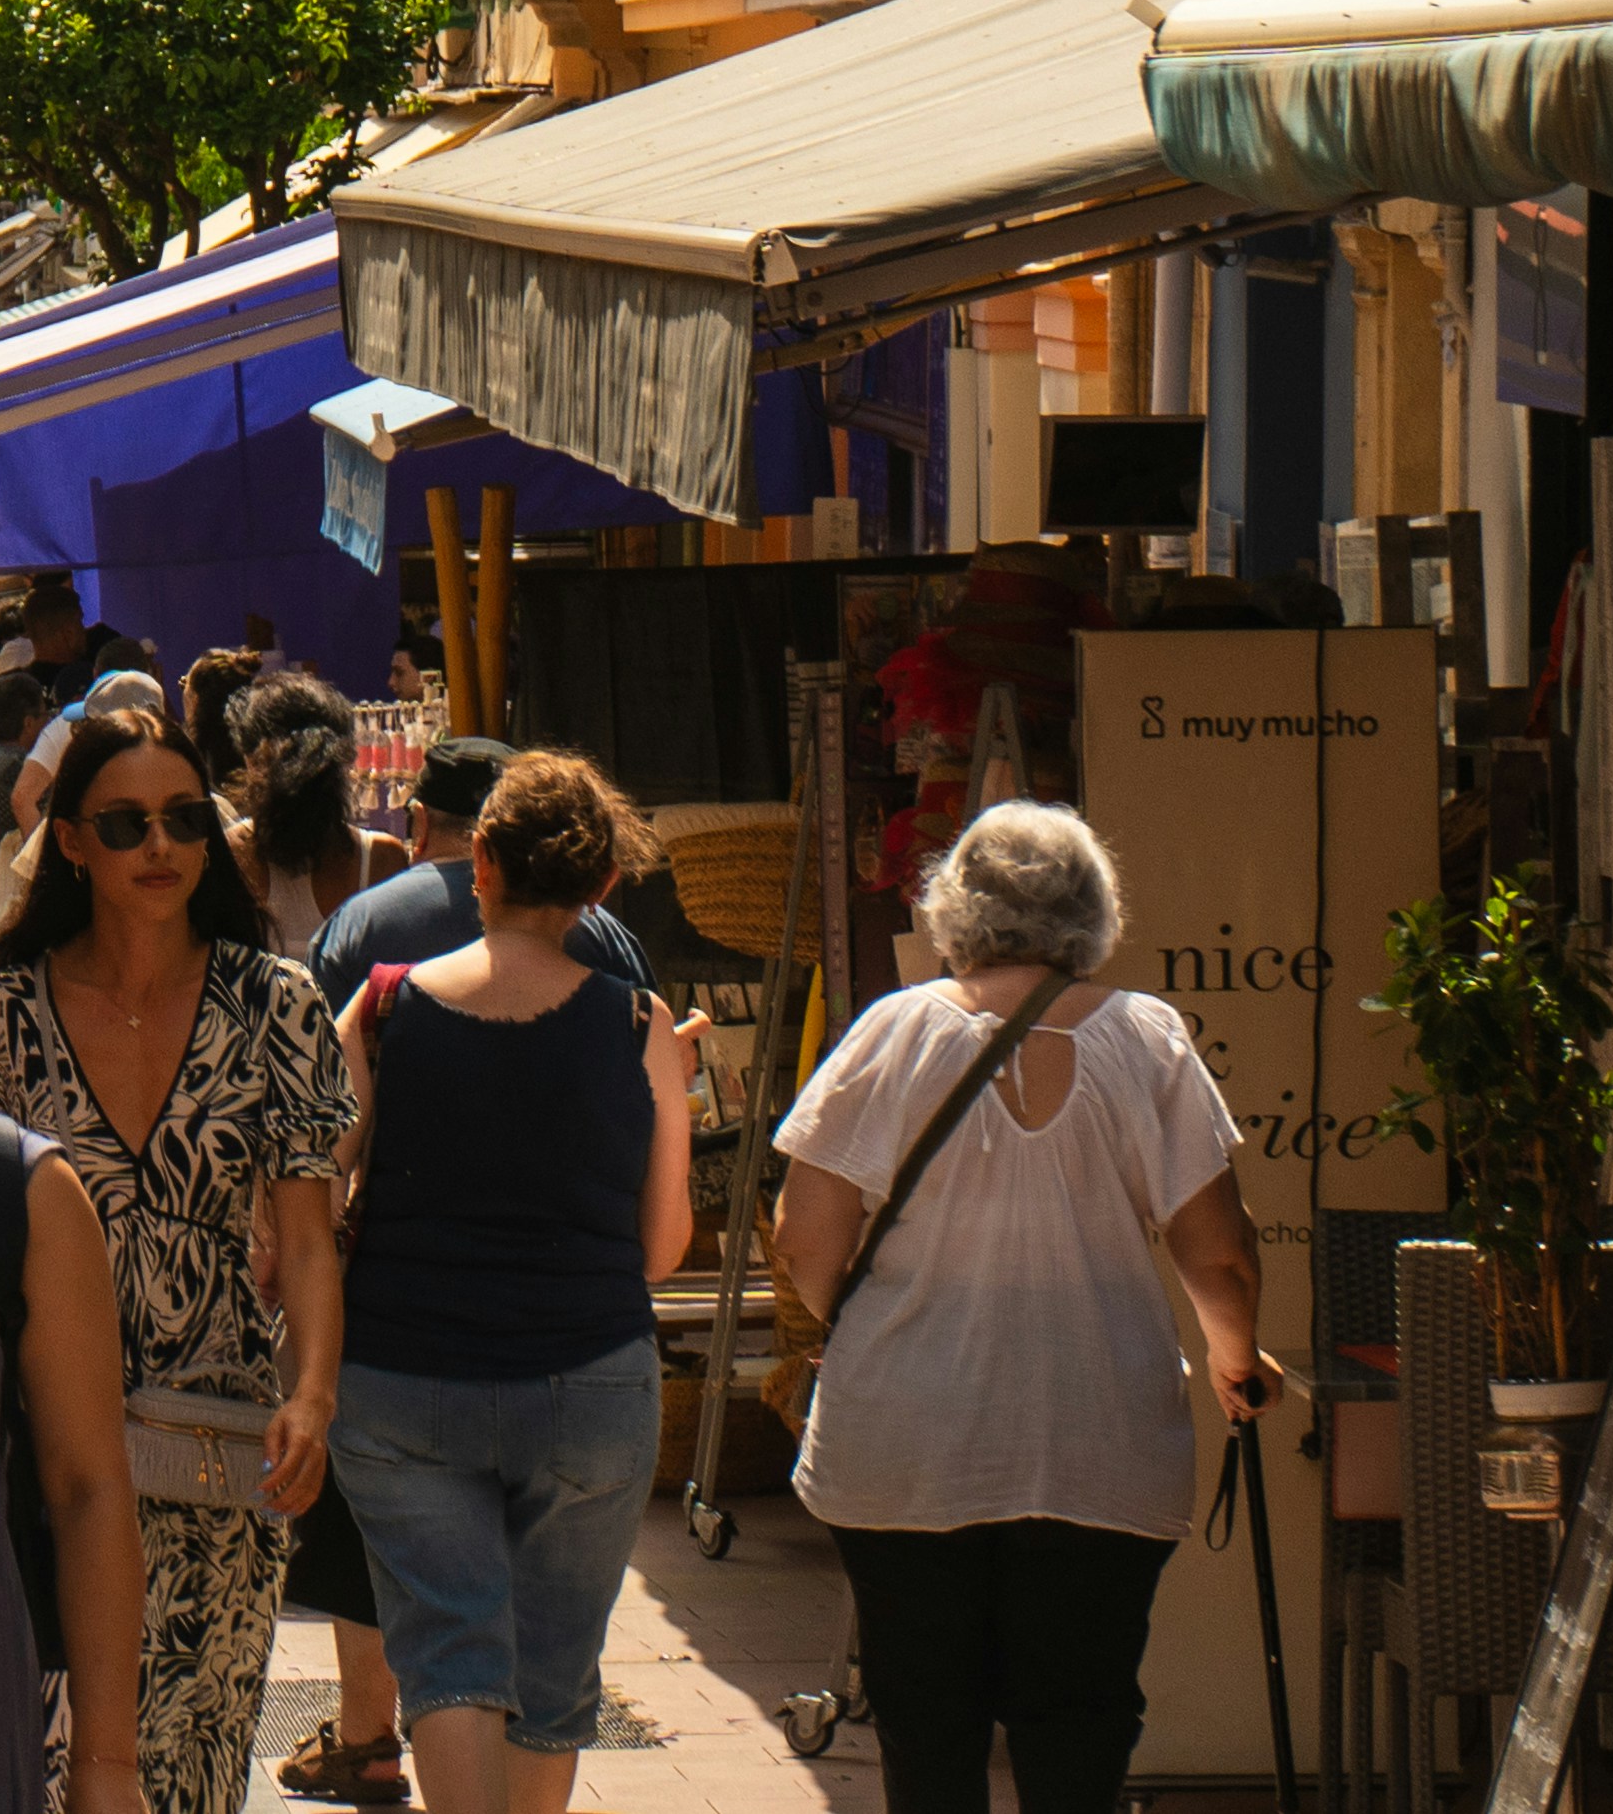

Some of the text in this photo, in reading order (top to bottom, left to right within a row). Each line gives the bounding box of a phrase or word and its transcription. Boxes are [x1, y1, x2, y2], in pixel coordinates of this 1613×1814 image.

[1182, 706, 1379, 744] muy mucho
[1156, 924, 1334, 993] nice
